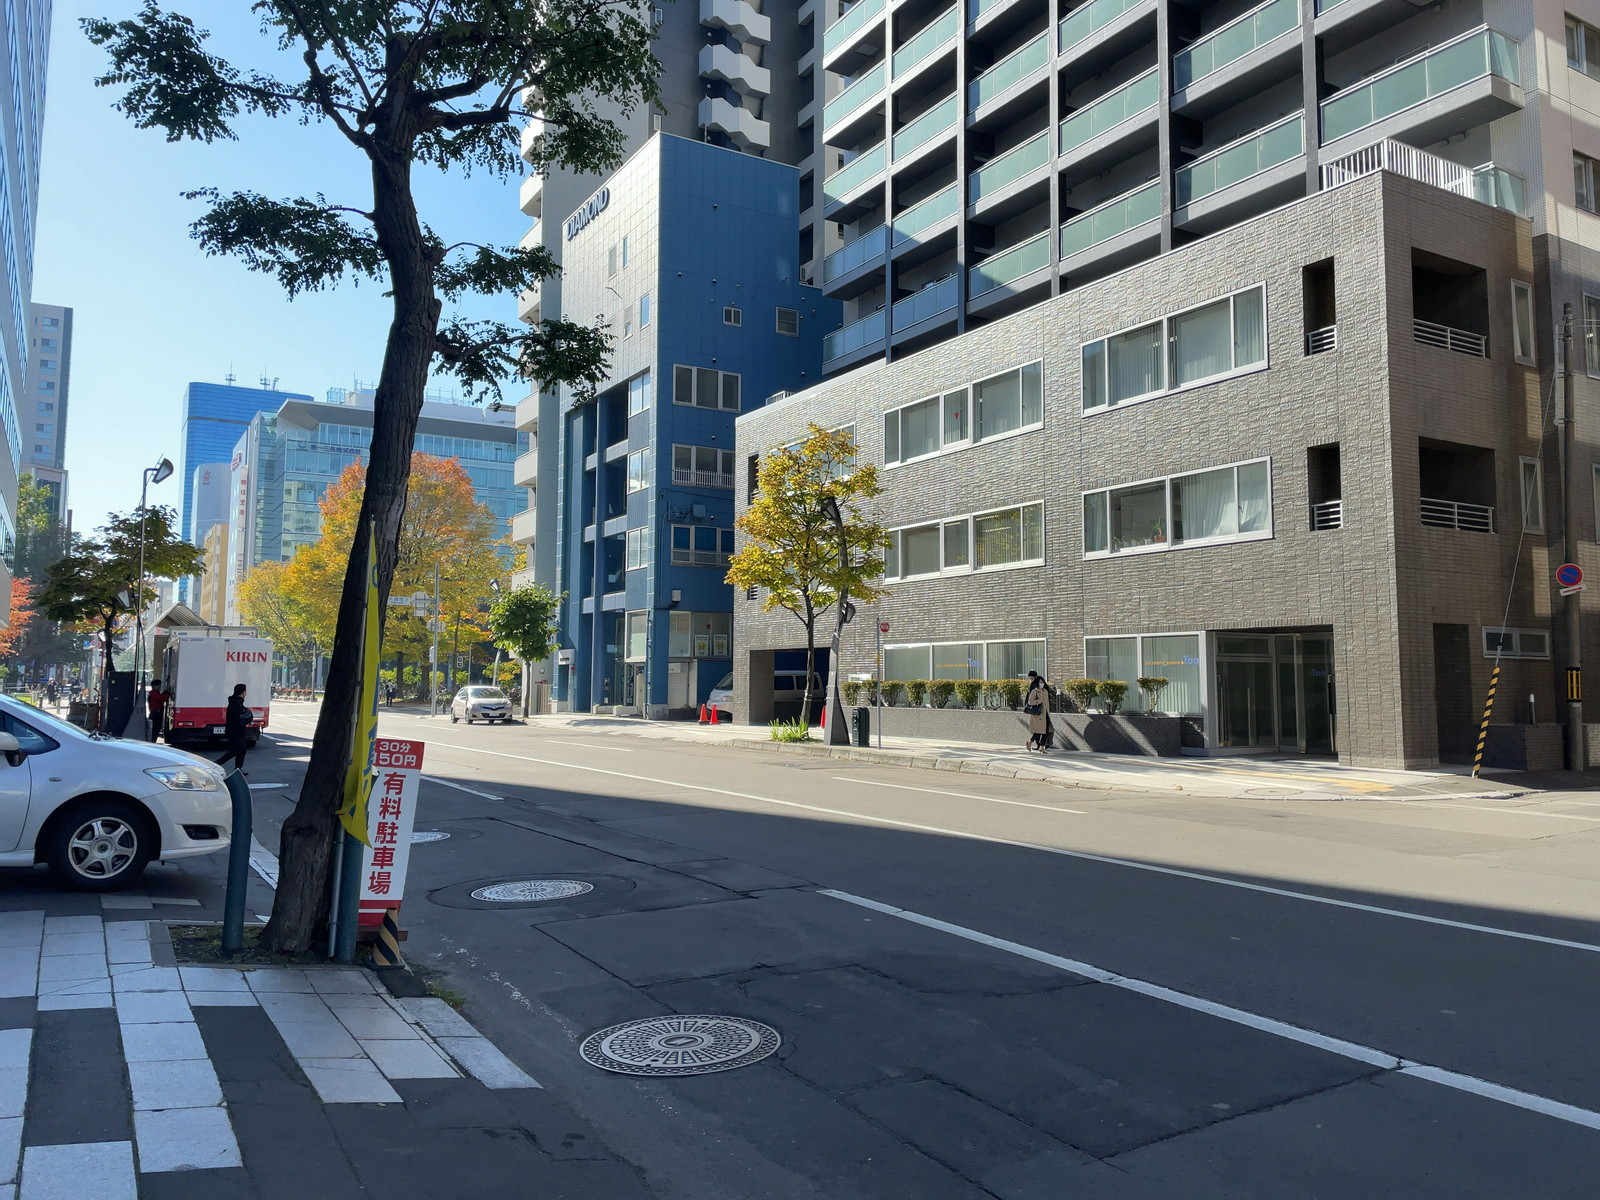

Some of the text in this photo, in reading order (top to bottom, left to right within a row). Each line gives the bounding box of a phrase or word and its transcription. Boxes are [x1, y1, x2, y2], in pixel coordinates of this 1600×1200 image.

[567, 187, 610, 242] DIAMOND
[226, 651, 267, 662] KIRIN
[379, 741, 411, 753] 30分
[367, 772, 406, 895] 有料駐車場
